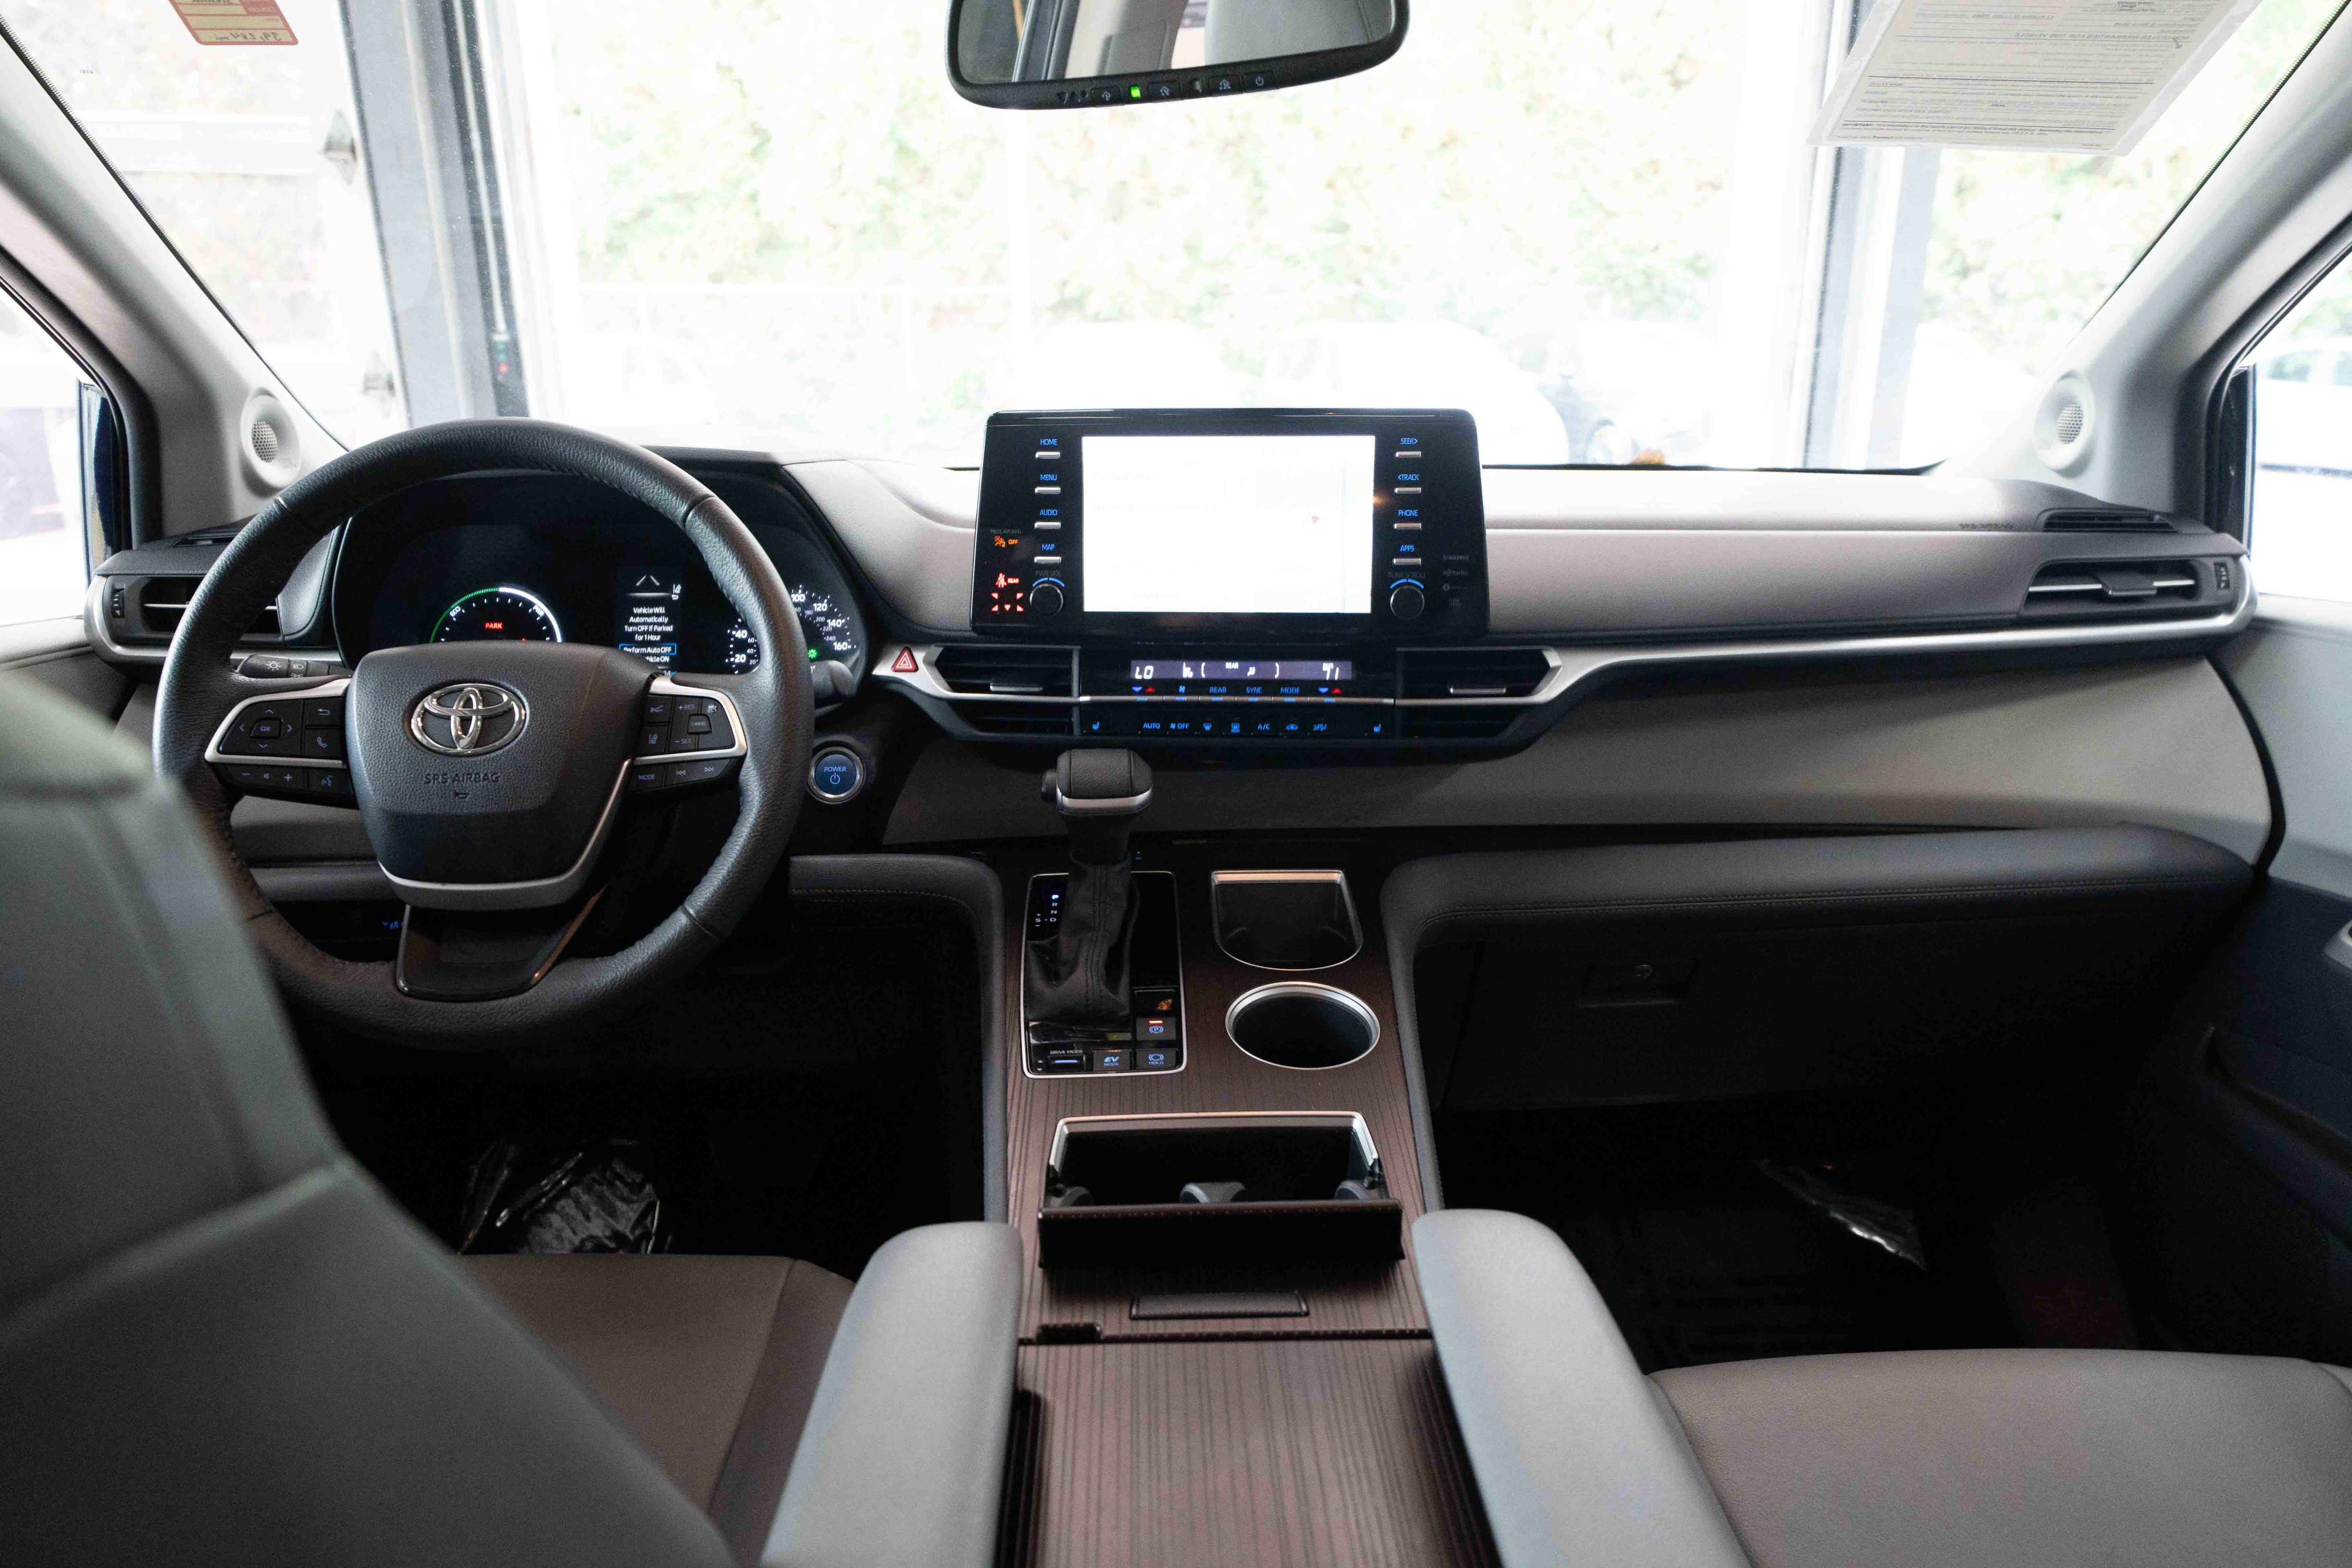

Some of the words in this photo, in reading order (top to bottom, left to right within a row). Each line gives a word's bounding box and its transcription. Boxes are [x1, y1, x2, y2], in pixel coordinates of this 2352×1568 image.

[791, 594, 805, 602] 100
[450, 606, 461, 617] ECO
[813, 602, 828, 612] 120
[827, 619, 842, 628] 140
[735, 630, 747, 639] 40
[833, 642, 848, 650] 160
[735, 654, 746, 663] 20
[1135, 666, 1154, 679] LO
[424, 773, 448, 784] SRS
[451, 773, 501, 784] AIRBAG
